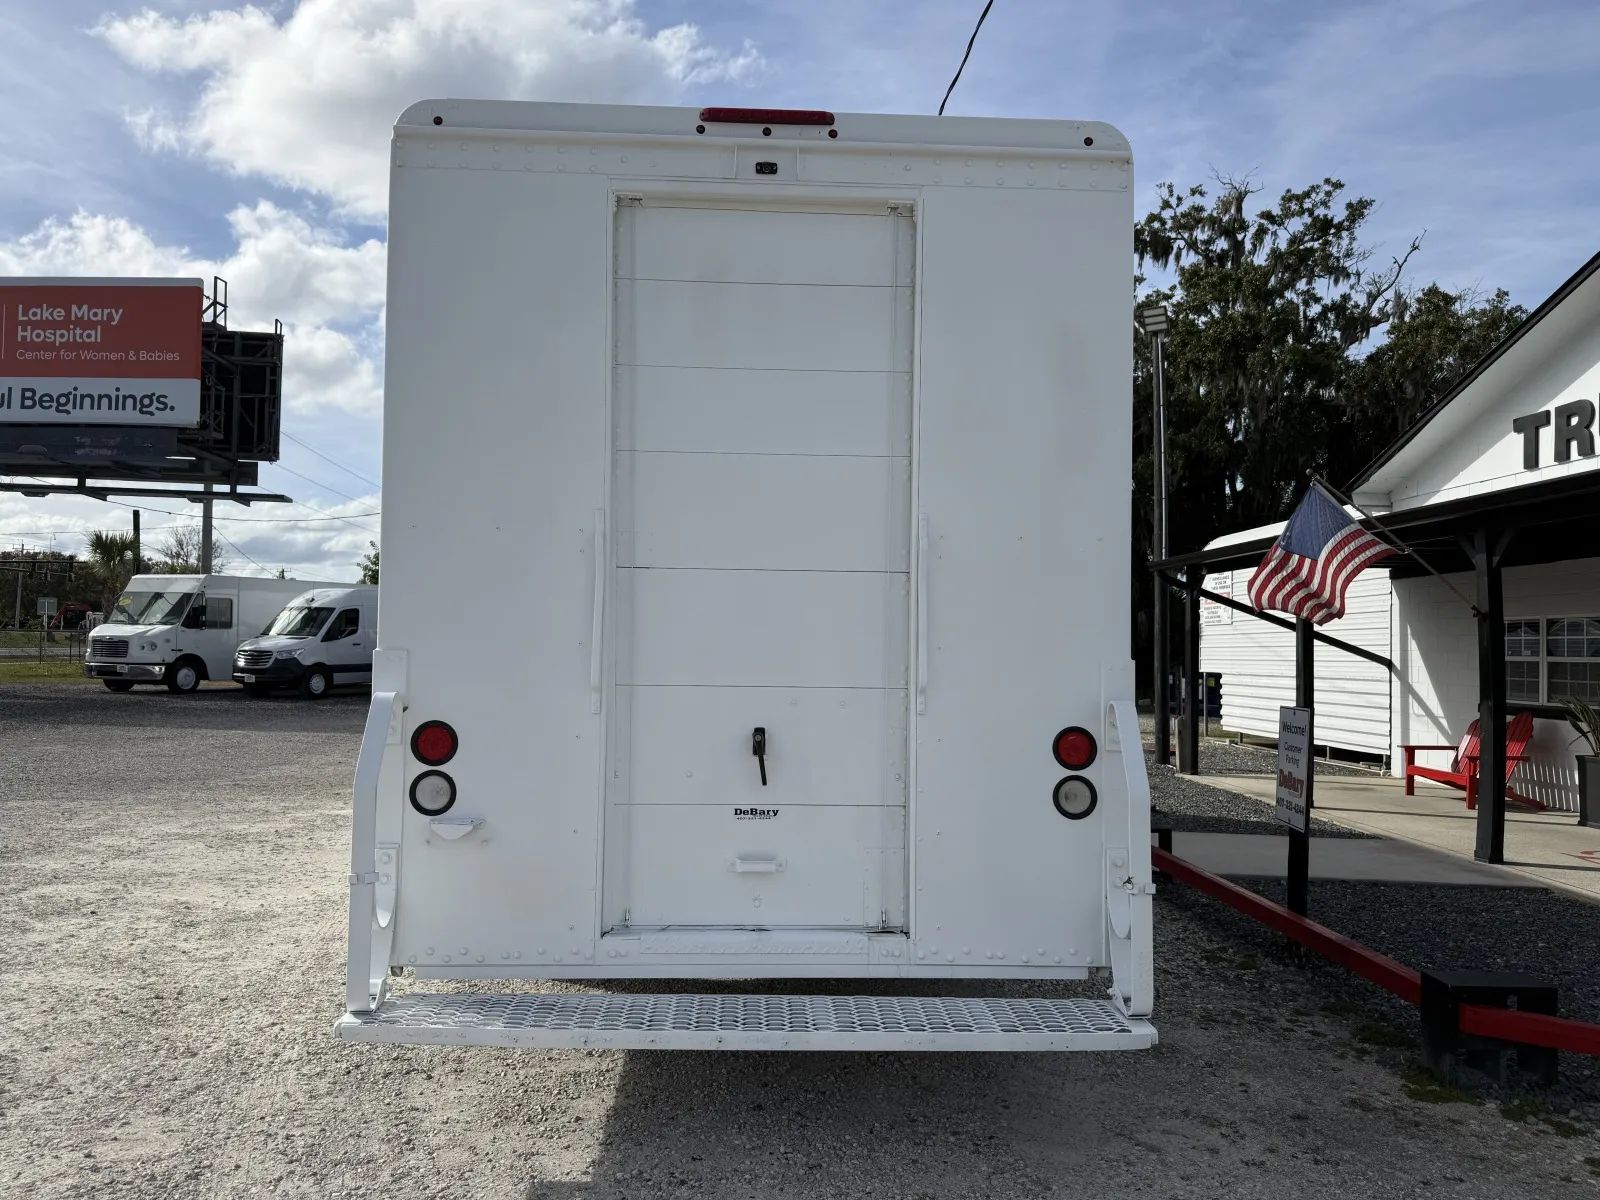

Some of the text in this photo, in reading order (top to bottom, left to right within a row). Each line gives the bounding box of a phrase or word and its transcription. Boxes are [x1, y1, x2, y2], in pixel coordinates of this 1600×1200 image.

[18, 304, 123, 325] Lake Mary
[17, 325, 101, 346] Hospital
[16, 349, 180, 361] Center for Women & Babies
[20, 386, 175, 416] Beginnings.
[1513, 393, 1600, 471] TR
[1282, 721, 1307, 736] Welcome!
[1284, 742, 1303, 754] Customer
[1285, 754, 1300, 768] Parking
[1278, 769, 1305, 798] DeBary
[734, 808, 779, 817] DeBary
